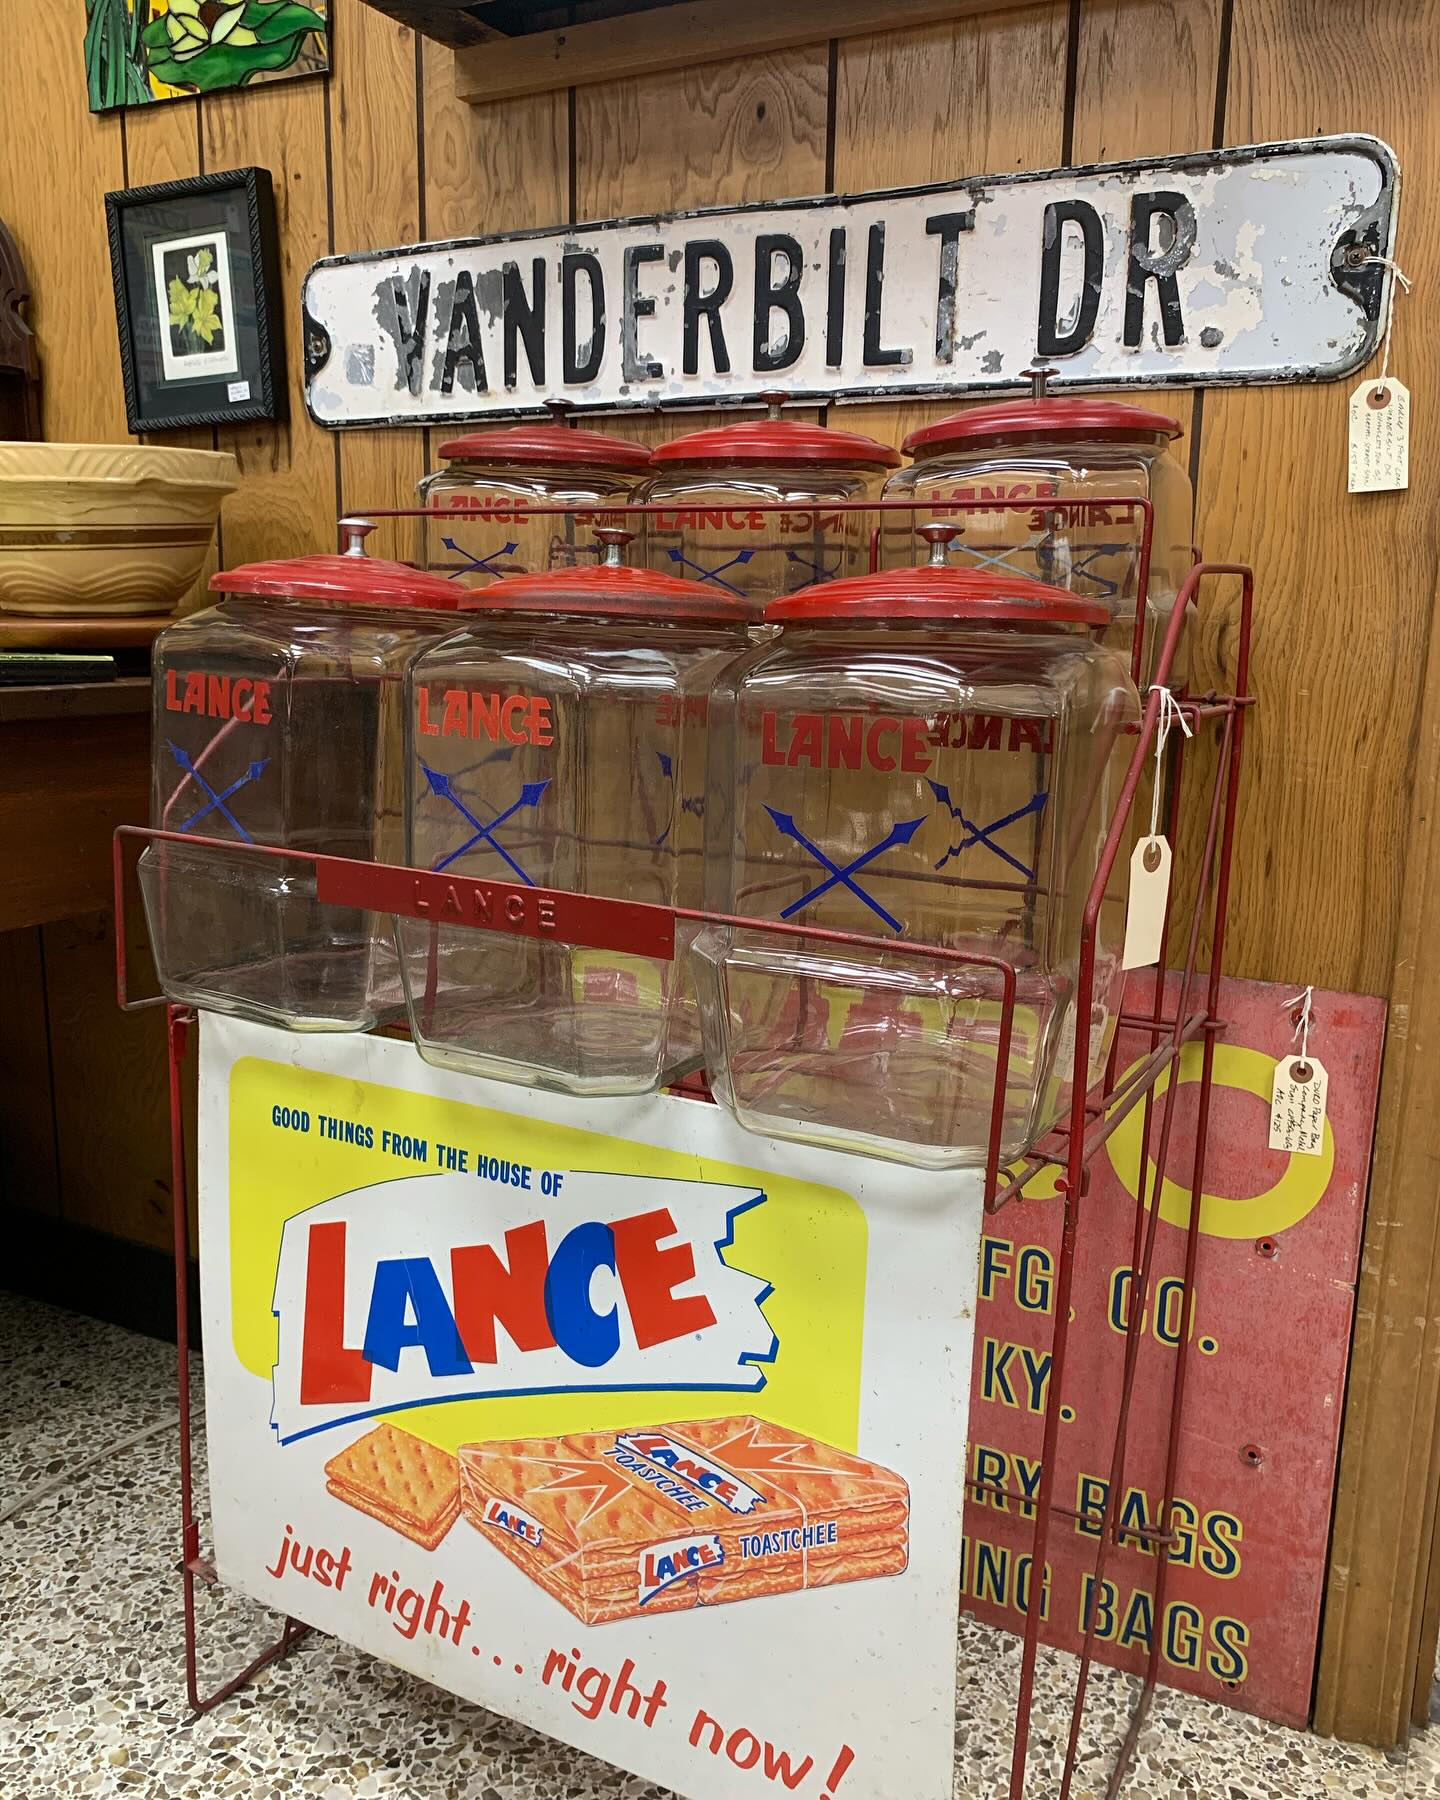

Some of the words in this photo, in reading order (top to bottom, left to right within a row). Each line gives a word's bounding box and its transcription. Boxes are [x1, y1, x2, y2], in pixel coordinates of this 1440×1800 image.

[392, 209, 976, 397] VANDERBILT
[1035, 190, 1224, 357] DR.
[432, 494, 530, 525] LANCE
[655, 501, 768, 530] LANCE
[931, 482, 1058, 517] LANCE
[165, 668, 273, 726] LANCE
[417, 686, 556, 747] LANCE
[761, 710, 934, 774] LANCE
[414, 879, 557, 931] LANCE
[272, 1104, 310, 1133] GOOD
[318, 1114, 374, 1149] THINGS
[382, 1129, 427, 1162] FROM
[436, 1143, 468, 1174] THE
[477, 1153, 532, 1190] HOUSE
[540, 1170, 564, 1198] OF
[1308, 1107, 1322, 1131] Paper
[300, 1207, 718, 1406] LANCE
[1108, 1264, 1220, 1356] CO.
[981, 1336, 1077, 1424] KY.
[602, 1446, 711, 1513] TOASTCHEE
[629, 1437, 740, 1504] LANCE
[487, 1501, 537, 1540] LANCE
[966, 1441, 1043, 1521] RY
[1075, 1471, 1245, 1580] BAGS
[643, 1543, 718, 1588] LANCE
[740, 1522, 838, 1559] TOASTCHEE
[264, 1524, 354, 1592] just
[541, 1646, 669, 1728] right
[1078, 1572, 1250, 1684] BAGS
